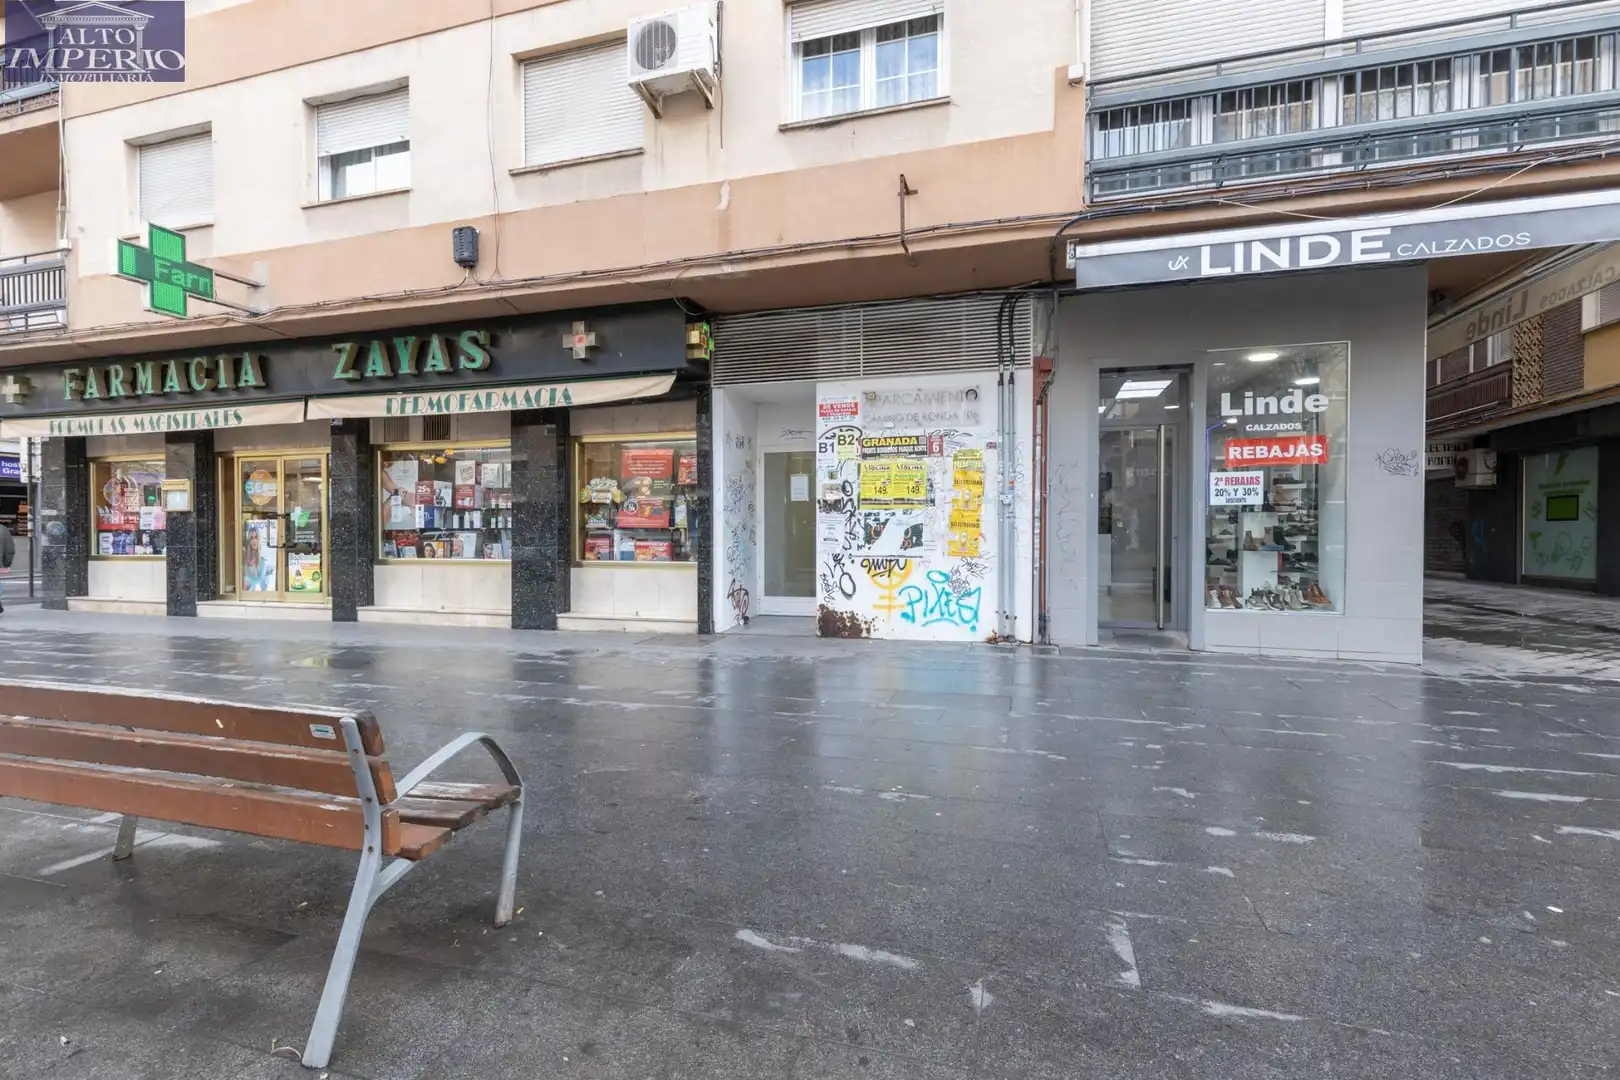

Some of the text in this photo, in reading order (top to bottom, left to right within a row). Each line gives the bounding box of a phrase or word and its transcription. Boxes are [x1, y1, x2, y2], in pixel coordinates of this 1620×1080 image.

[1200, 227, 1532, 276] LINDE CALZADOS
[62, 329, 491, 400] FARMACIA ZAYAS
[385, 384, 573, 416] DERMOFARMACIA
[1221, 389, 1329, 416] Linde
[133, 408, 243, 433] MAGISTRALES
[1245, 422, 1302, 432] CALZADOS
[837, 435, 855, 446] B2
[862, 436, 918, 447] GRANADA
[818, 442, 835, 453] B1
[933, 441, 940, 453] 6
[1228, 443, 1324, 460] REBAJAS
[1225, 475, 1260, 486] REBAJAS
[1214, 487, 1260, 497] 20% Y 30%
